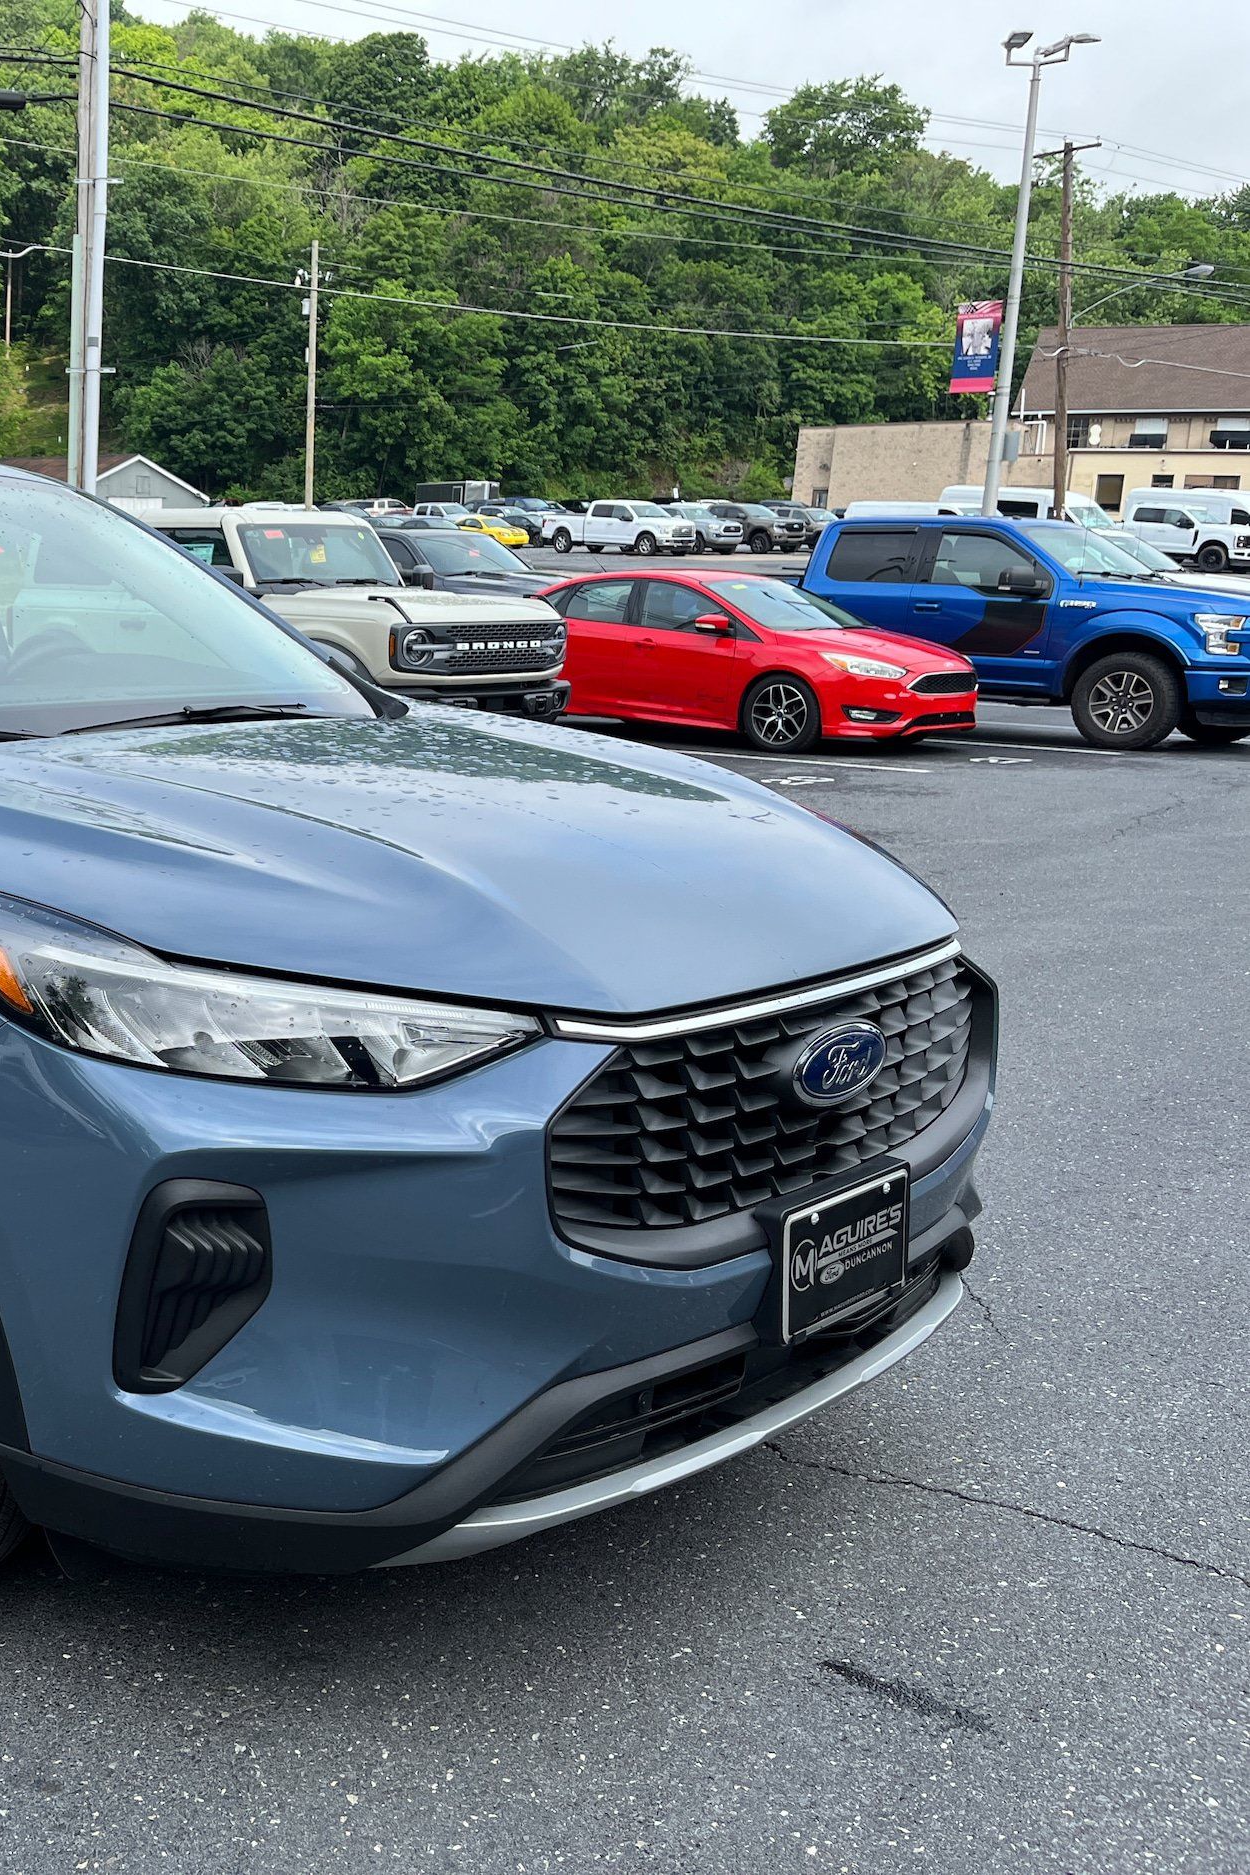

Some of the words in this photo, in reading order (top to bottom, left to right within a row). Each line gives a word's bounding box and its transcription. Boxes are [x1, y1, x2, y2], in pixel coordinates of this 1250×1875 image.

[456, 640, 541, 651] BRONCO
[822, 1040, 872, 1090] Ford
[845, 1241, 893, 1270] DUNCANNON
